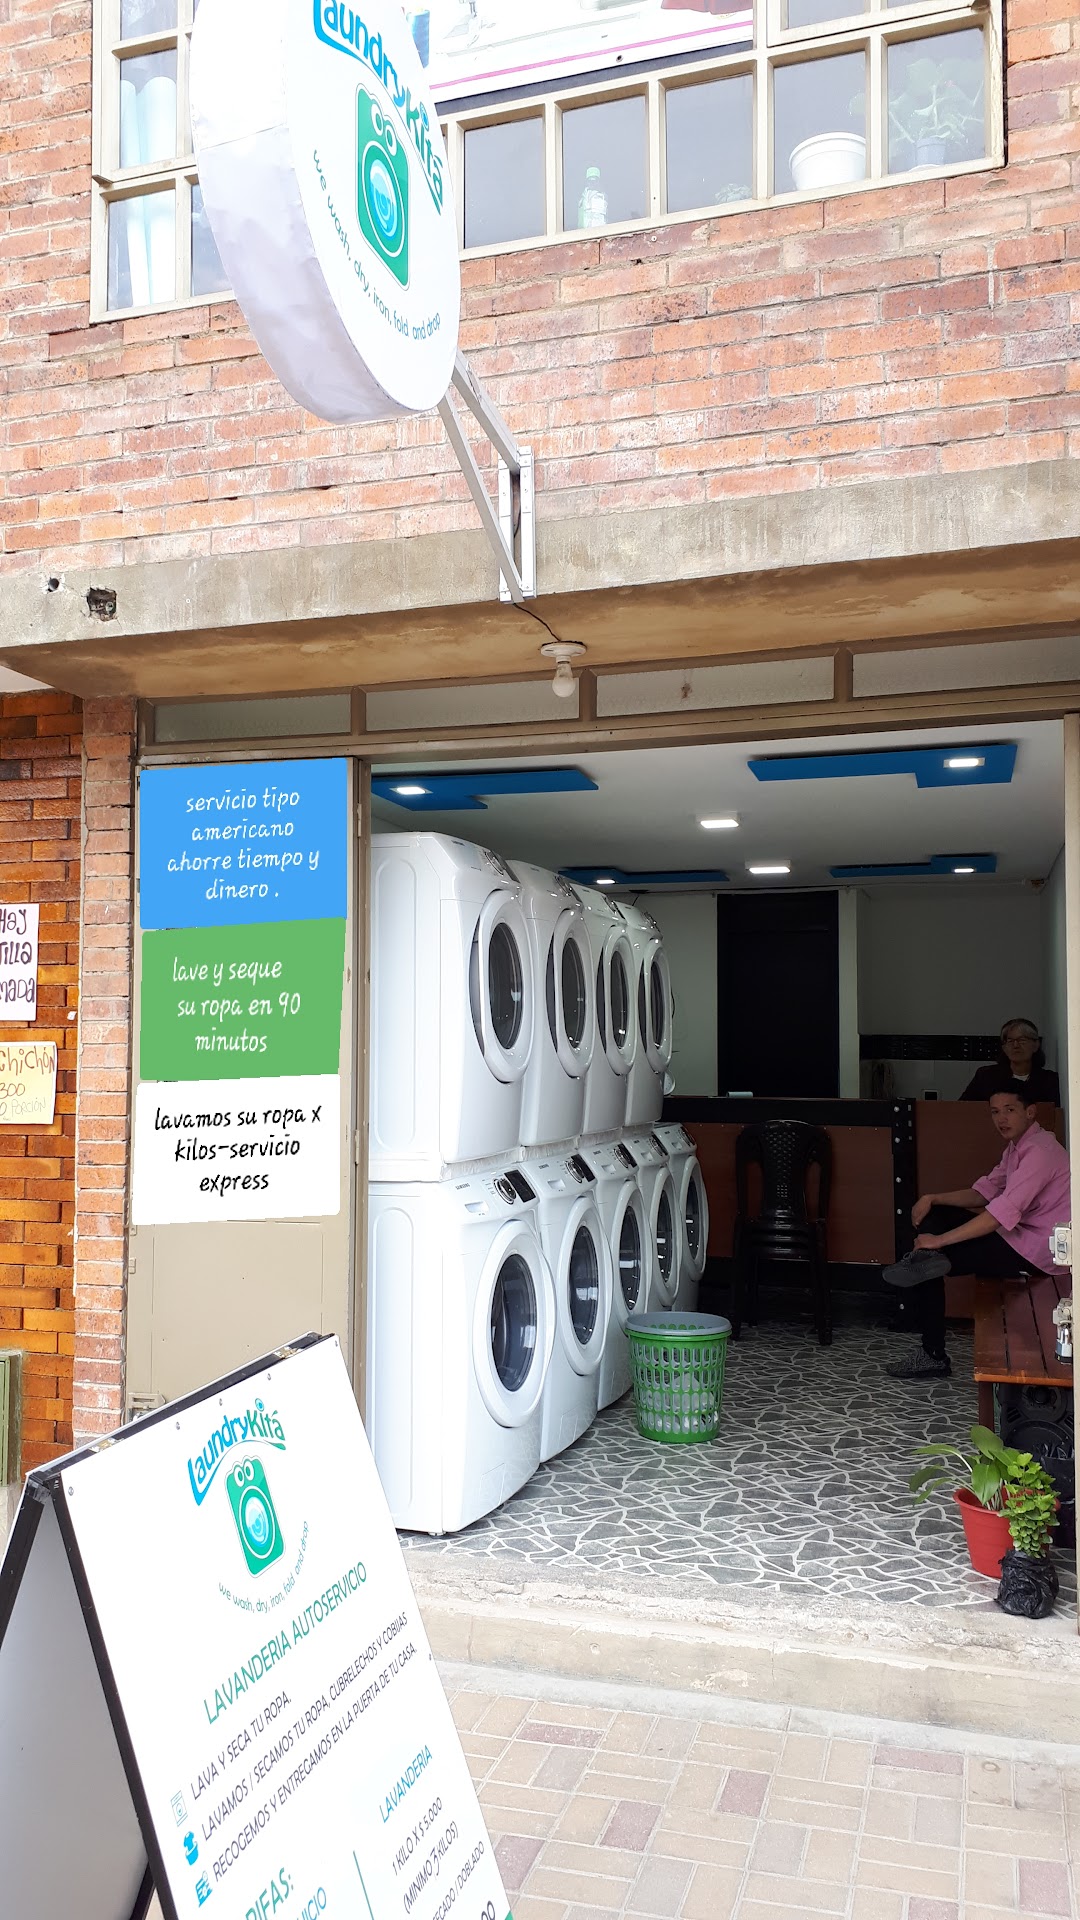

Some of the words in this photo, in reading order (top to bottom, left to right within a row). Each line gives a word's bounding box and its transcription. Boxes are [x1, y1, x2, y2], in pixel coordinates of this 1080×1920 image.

[313, 149, 327, 191] we
[412, 325, 426, 341] and
[426, 312, 441, 337] drop
[218, 1582, 232, 1601] we
[294, 1548, 304, 1575] and
[301, 1520, 309, 1551] drop
[203, 1630, 292, 1725] LAVANDERIA
[291, 1561, 367, 1646] AUTOSERVICIO
[190, 1761, 220, 1801] LAVA
[217, 1751, 226, 1770] Y
[226, 1728, 252, 1763] SECA
[250, 1714, 265, 1738] TU
[201, 1778, 249, 1842] LAVAMOS
[253, 1730, 294, 1784] SECAMOS
[292, 1716, 306, 1739] TU
[304, 1694, 331, 1728] ROPA,
[329, 1641, 378, 1701] CUBRELECHOS
[376, 1635, 383, 1651] Y
[382, 1611, 408, 1645] COBIJAS
[212, 1803, 271, 1882] RECOGEMOS
[269, 1793, 278, 1813] Y
[277, 1733, 332, 1806] ENTREGAMOS
[330, 1720, 344, 1744] EN
[341, 1710, 355, 1731] LA
[352, 1680, 381, 1719] PUERTA
[378, 1668, 391, 1689] DE
[388, 1658, 399, 1678] TU
[379, 1744, 433, 1824] LAVANDERIA
[392, 1861, 398, 1876] 1
[395, 1836, 414, 1871] KILO
[412, 1825, 421, 1846] X
[403, 1858, 433, 1915] (MINIMO
[457, 1840, 485, 1890] DOBLADO
